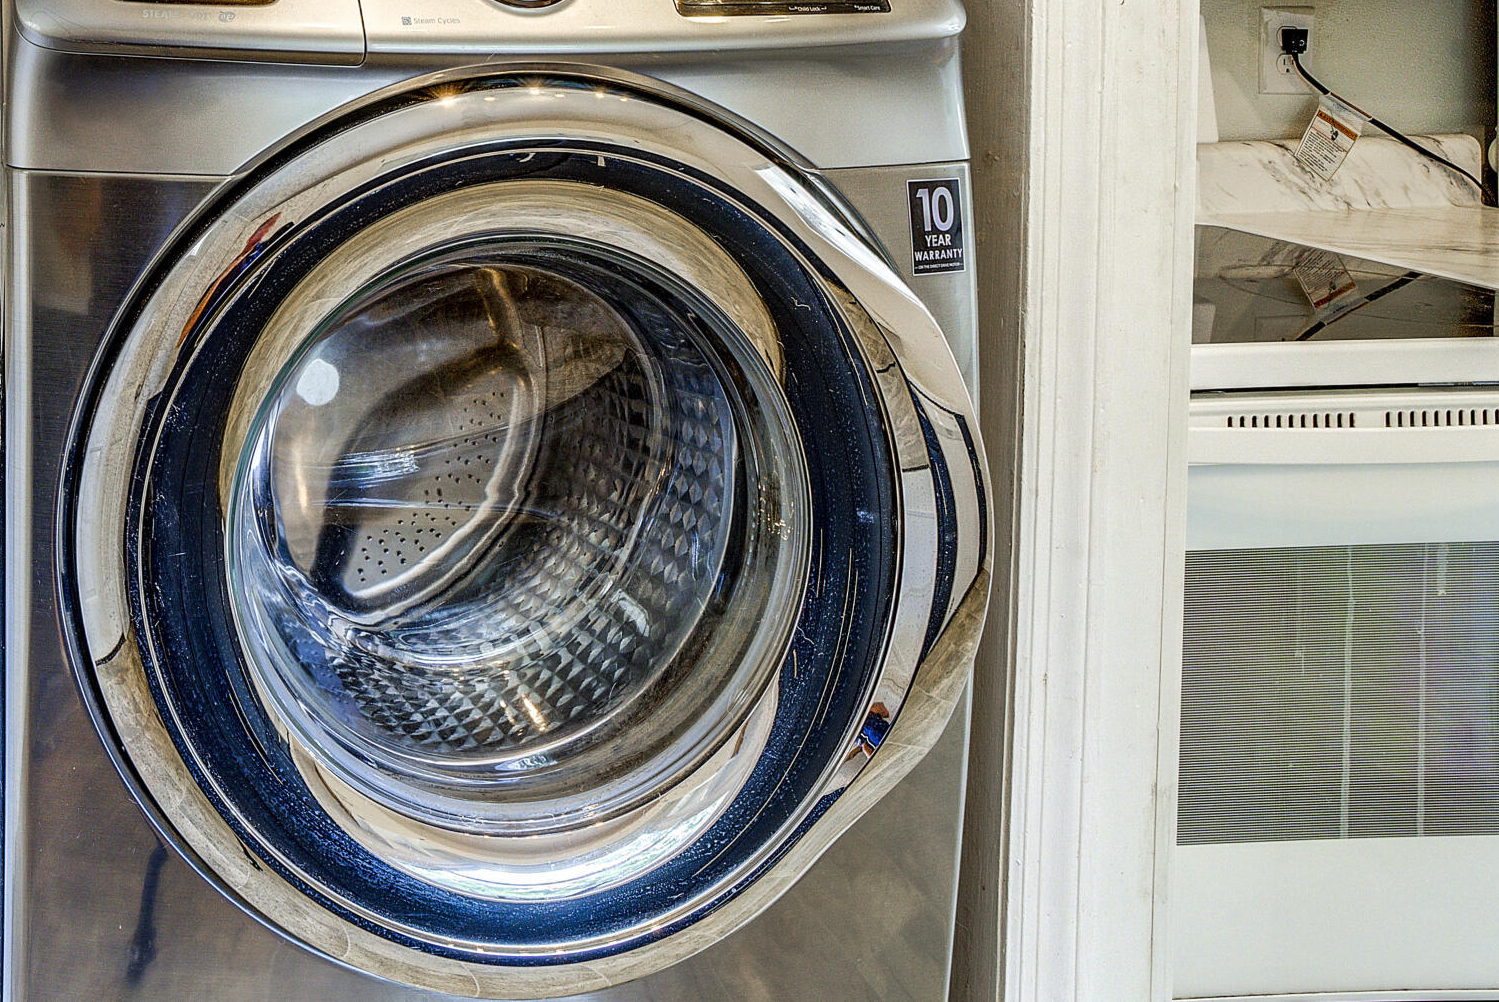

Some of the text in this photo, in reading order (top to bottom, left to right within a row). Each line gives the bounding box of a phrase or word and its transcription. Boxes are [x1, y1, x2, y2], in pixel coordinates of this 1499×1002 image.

[916, 186, 955, 232] 10
[925, 234, 952, 247] YEAR
[914, 248, 963, 262] WARRANTY
